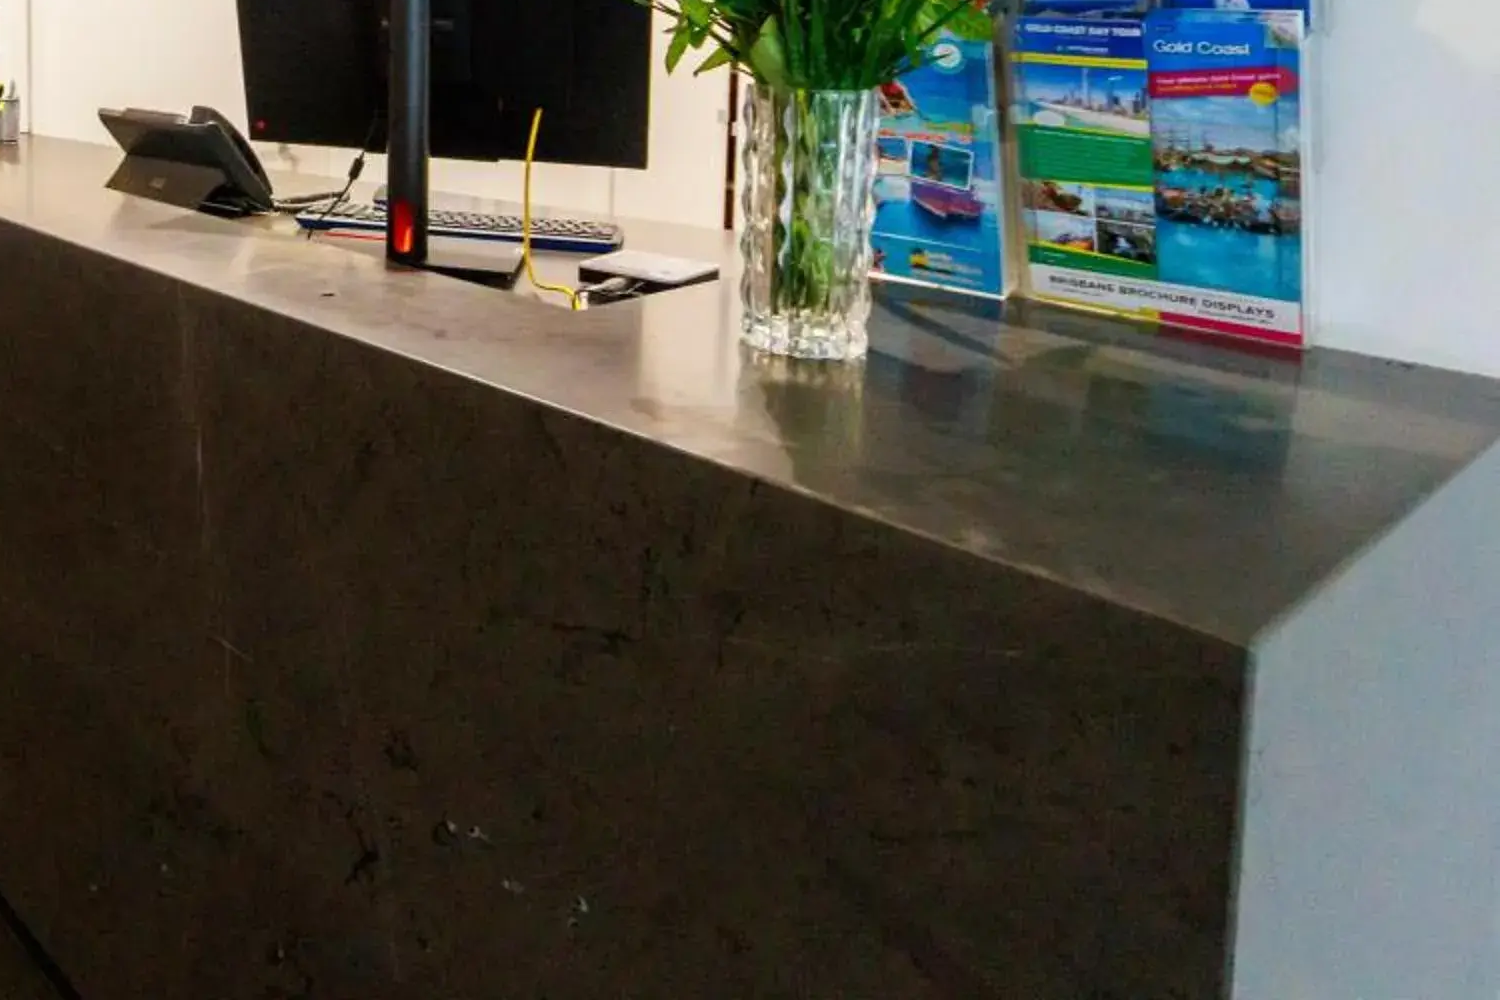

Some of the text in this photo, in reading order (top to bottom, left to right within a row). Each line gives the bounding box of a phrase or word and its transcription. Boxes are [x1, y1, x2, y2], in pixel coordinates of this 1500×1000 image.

[1153, 39, 1251, 56] Gold Coast
[1048, 274, 1116, 294] BRISBANE
[1118, 285, 1198, 309] BROCHURE
[1201, 297, 1276, 320] DISPLAYS
